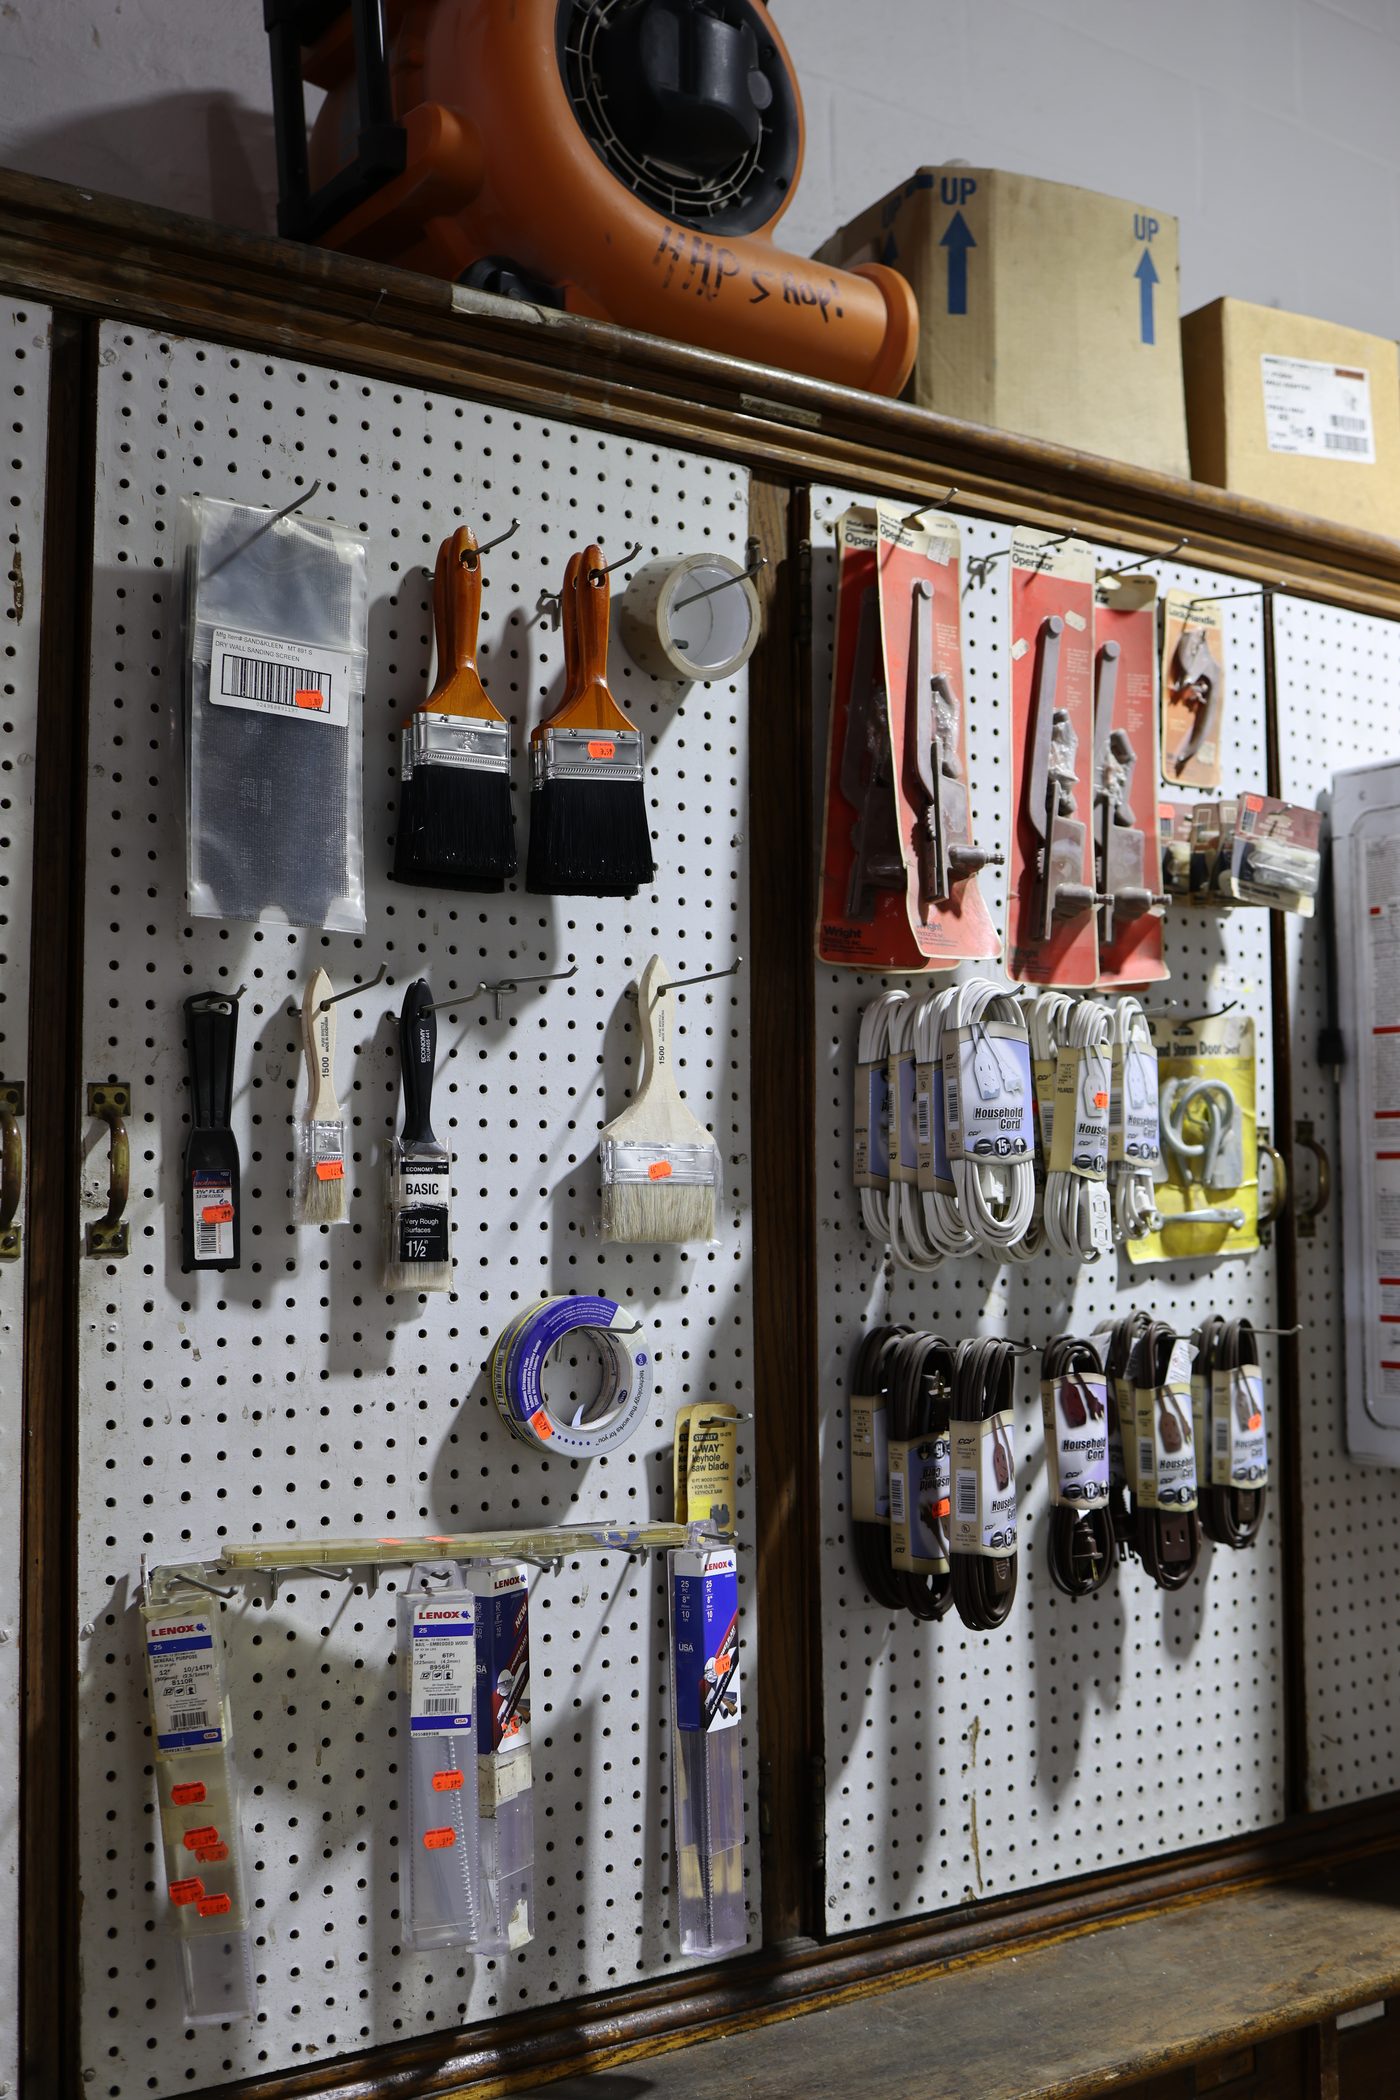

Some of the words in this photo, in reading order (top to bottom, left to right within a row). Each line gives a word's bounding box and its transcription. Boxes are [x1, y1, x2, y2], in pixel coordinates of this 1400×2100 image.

[941, 177, 977, 205] UP
[1133, 214, 1160, 242] UP
[216, 631, 226, 639] Mfg
[244, 636, 283, 650] SAND&KLEEN
[229, 643, 246, 652] WALL
[247, 647, 274, 657] SANDING
[276, 651, 300, 662] SCREEN
[824, 925, 862, 938] Wright
[419, 1028, 427, 1063] ECONOMY
[1200, 1041, 1221, 1055] Door
[321, 1056, 330, 1079] 1500
[974, 1107, 1023, 1118] Household
[1000, 1118, 1021, 1129] Cord
[405, 1183, 439, 1195] BASIC
[404, 1218, 418, 1226] Very
[419, 1218, 439, 1226] Rough
[634, 1371, 646, 1404] technology
[628, 1406, 637, 1417] that
[616, 1418, 630, 1432] works
[608, 1431, 618, 1440] for
[692, 1454, 720, 1465] keyhole
[1087, 1450, 1104, 1460] Cord
[708, 1461, 729, 1471] blade
[704, 1561, 728, 1572] LENOX
[494, 1575, 520, 1590] LENOX
[680, 1580, 689, 1588] 25
[706, 1580, 712, 1588] 25
[418, 1611, 460, 1620] LENOX
[514, 1601, 527, 1629] NEW
[681, 1610, 690, 1618] 10
[707, 1610, 713, 1619] 10
[151, 1624, 195, 1637] LENOX
[678, 1643, 693, 1652] USA
